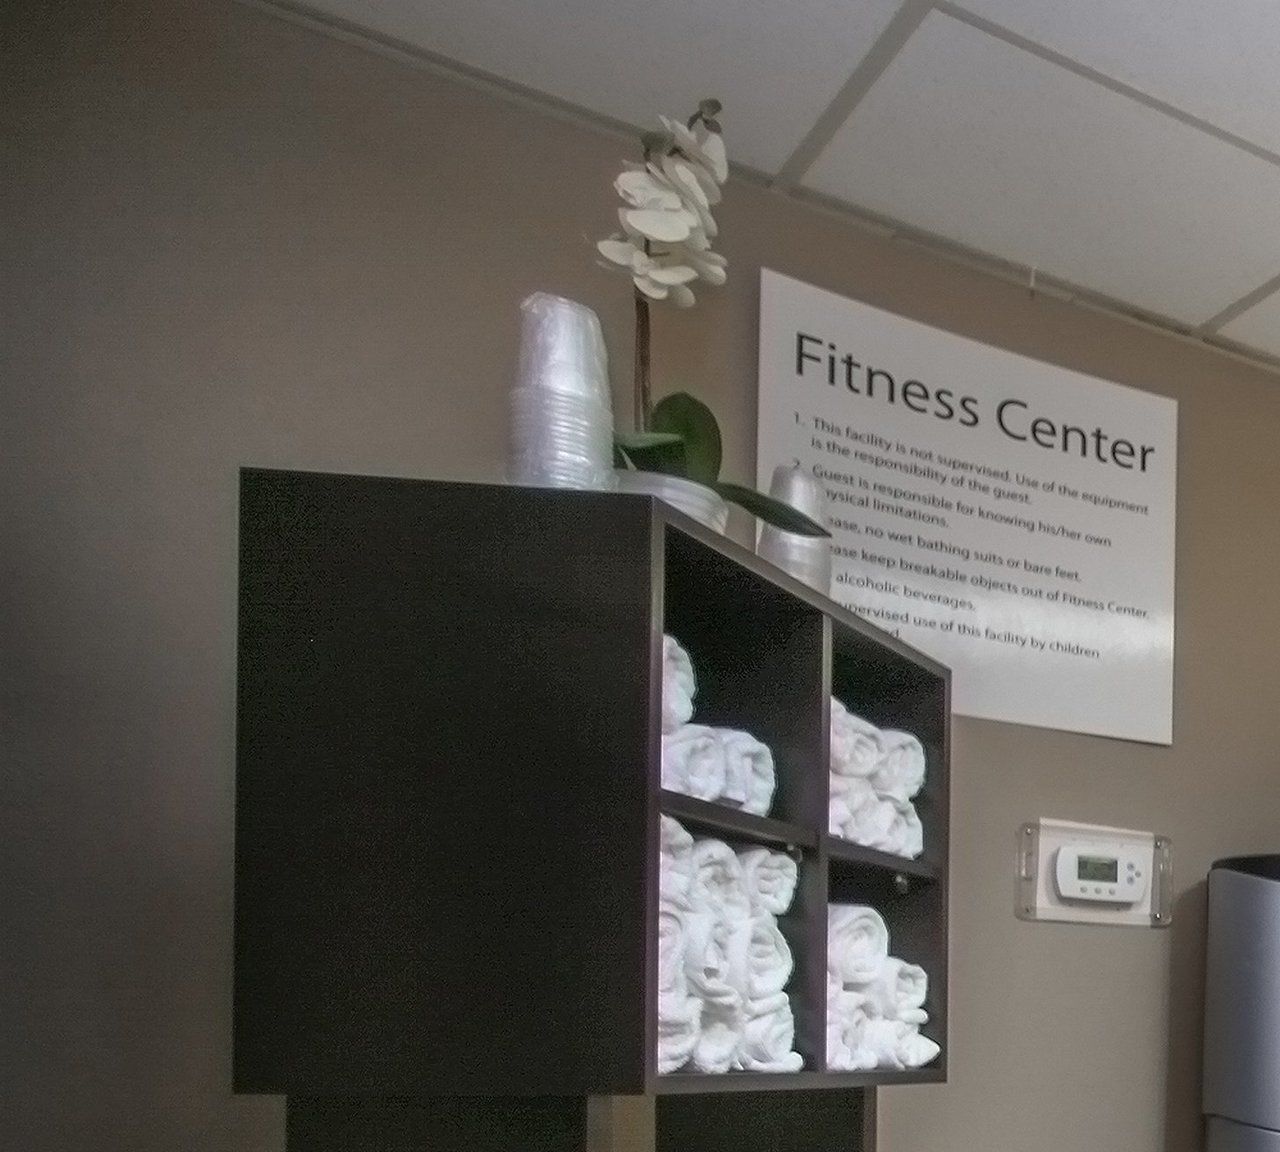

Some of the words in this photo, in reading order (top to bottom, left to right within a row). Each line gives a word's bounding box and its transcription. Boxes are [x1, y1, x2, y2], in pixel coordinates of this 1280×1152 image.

[796, 332, 979, 427] Fitness
[995, 399, 1155, 473] Center
[811, 437, 822, 450] is
[826, 440, 850, 457] the
[854, 450, 947, 486] responsibility
[951, 475, 964, 488] of
[968, 477, 990, 494] the
[993, 486, 1032, 506] guest.
[813, 417, 841, 436] This
[845, 426, 892, 452] facility
[896, 442, 906, 454] is
[910, 446, 933, 461] not
[937, 453, 1010, 481] supervised.
[1016, 472, 1038, 488] Use
[1042, 481, 1055, 493] of
[1058, 484, 1078, 498] the
[1082, 491, 1149, 516] equipment
[812, 464, 854, 485] Guest
[858, 476, 869, 490] is
[873, 481, 953, 511] responsible
[956, 500, 975, 518] for
[978, 506, 1035, 533] knowing
[1038, 520, 1082, 541] his/her
[1085, 533, 1112, 547] own
[826, 488, 870, 510] ysical
[873, 500, 950, 529] limitations.
[861, 550, 896, 570] keep
[899, 557, 967, 583] breakable
[970, 574, 1018, 595] objects
[1021, 585, 1043, 600] out
[1046, 589, 1060, 602] of
[1062, 593, 1105, 612] Fitness
[1107, 600, 1151, 621] Center.
[865, 525, 884, 539] no
[887, 530, 913, 546] wet
[917, 536, 970, 560] bathing
[973, 549, 1003, 567] suits
[1006, 558, 1020, 571] or
[1023, 558, 1052, 576] bare
[1055, 565, 1082, 583] feet.
[836, 572, 900, 597] alcoholic
[903, 584, 976, 613] beverages.
[913, 616, 937, 630] use
[940, 621, 954, 633] of
[957, 624, 981, 639] this
[984, 626, 1027, 648] facility
[1030, 633, 1046, 651] by
[1049, 638, 1100, 660] children
